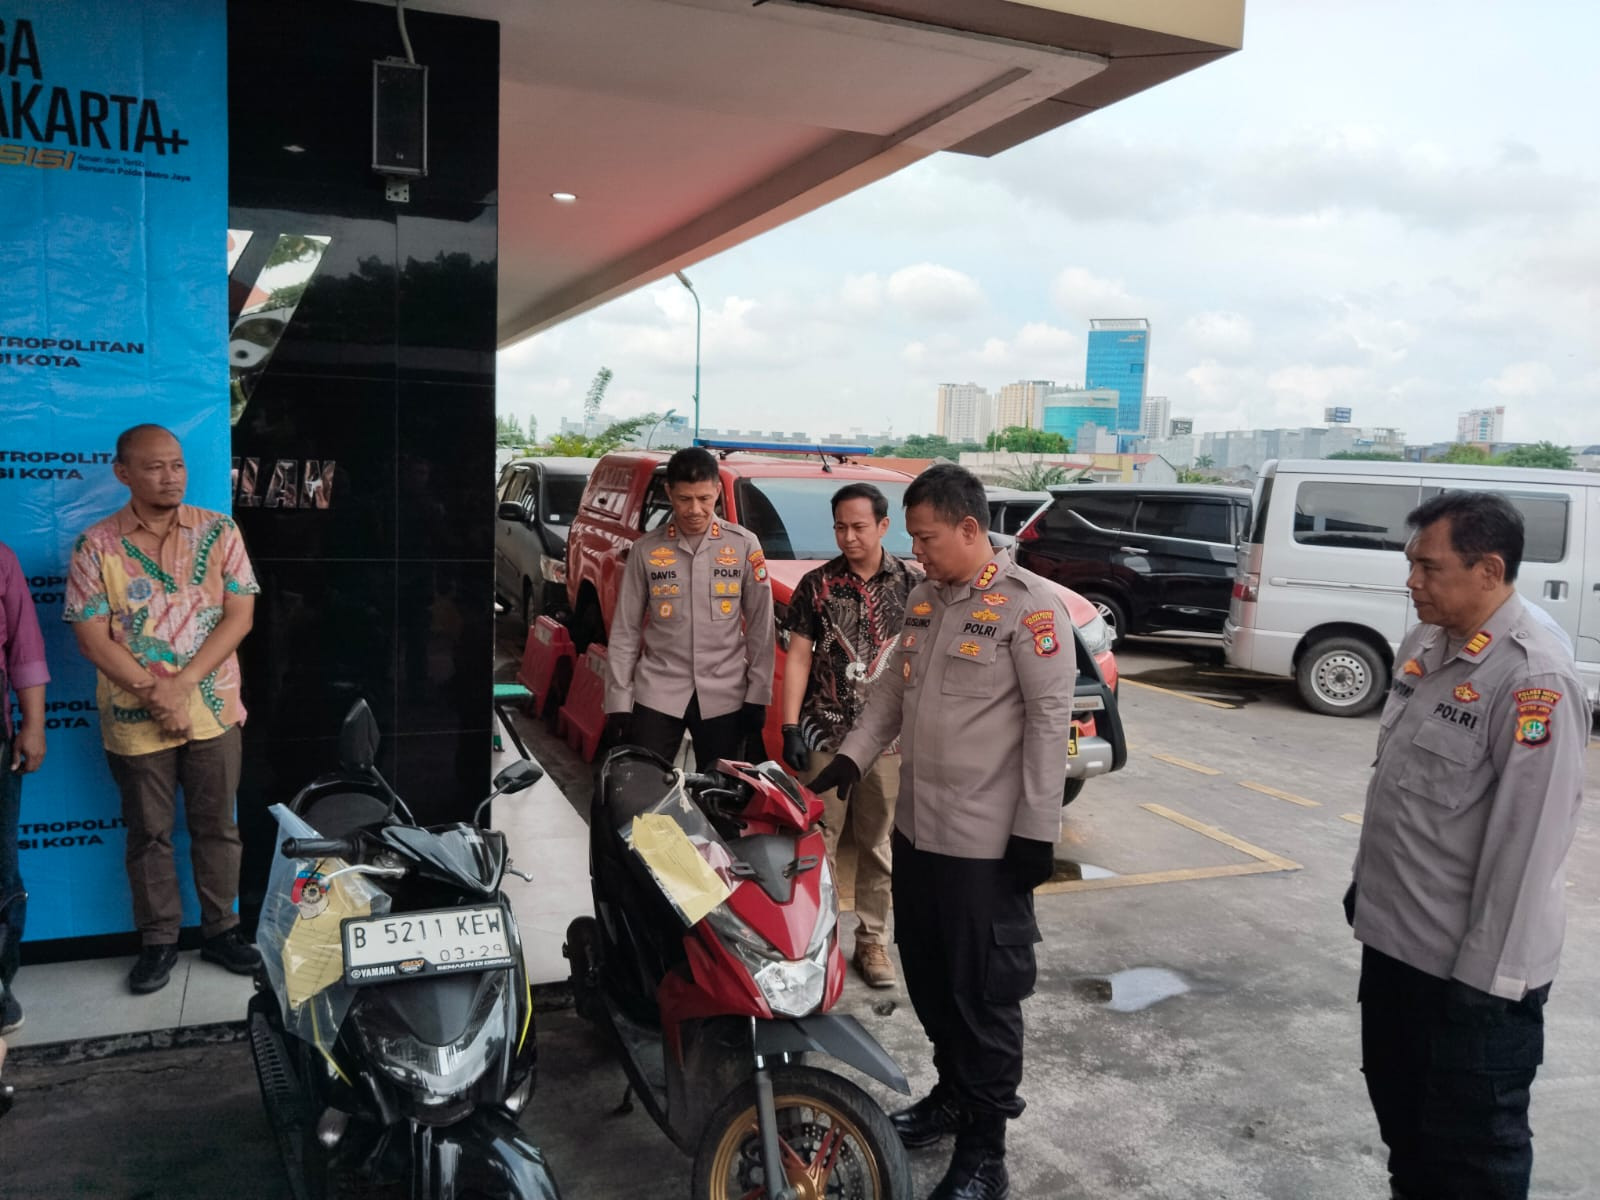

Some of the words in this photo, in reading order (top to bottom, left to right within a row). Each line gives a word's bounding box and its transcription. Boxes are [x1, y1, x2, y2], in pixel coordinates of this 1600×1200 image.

[0, 19, 43, 81] A
[16, 354, 81, 368] KOTA
[19, 467, 84, 480] KOTA
[651, 570, 677, 581] DAVIS
[713, 567, 741, 577] POLRI
[963, 622, 997, 638] POLRI
[1433, 702, 1478, 729] POLRI
[18, 838, 38, 850] SI
[43, 834, 104, 849] KOTA
[353, 927, 367, 949] B
[384, 917, 443, 944] 5211
[456, 912, 500, 937] KEW
[361, 965, 395, 978] YAMAHA
